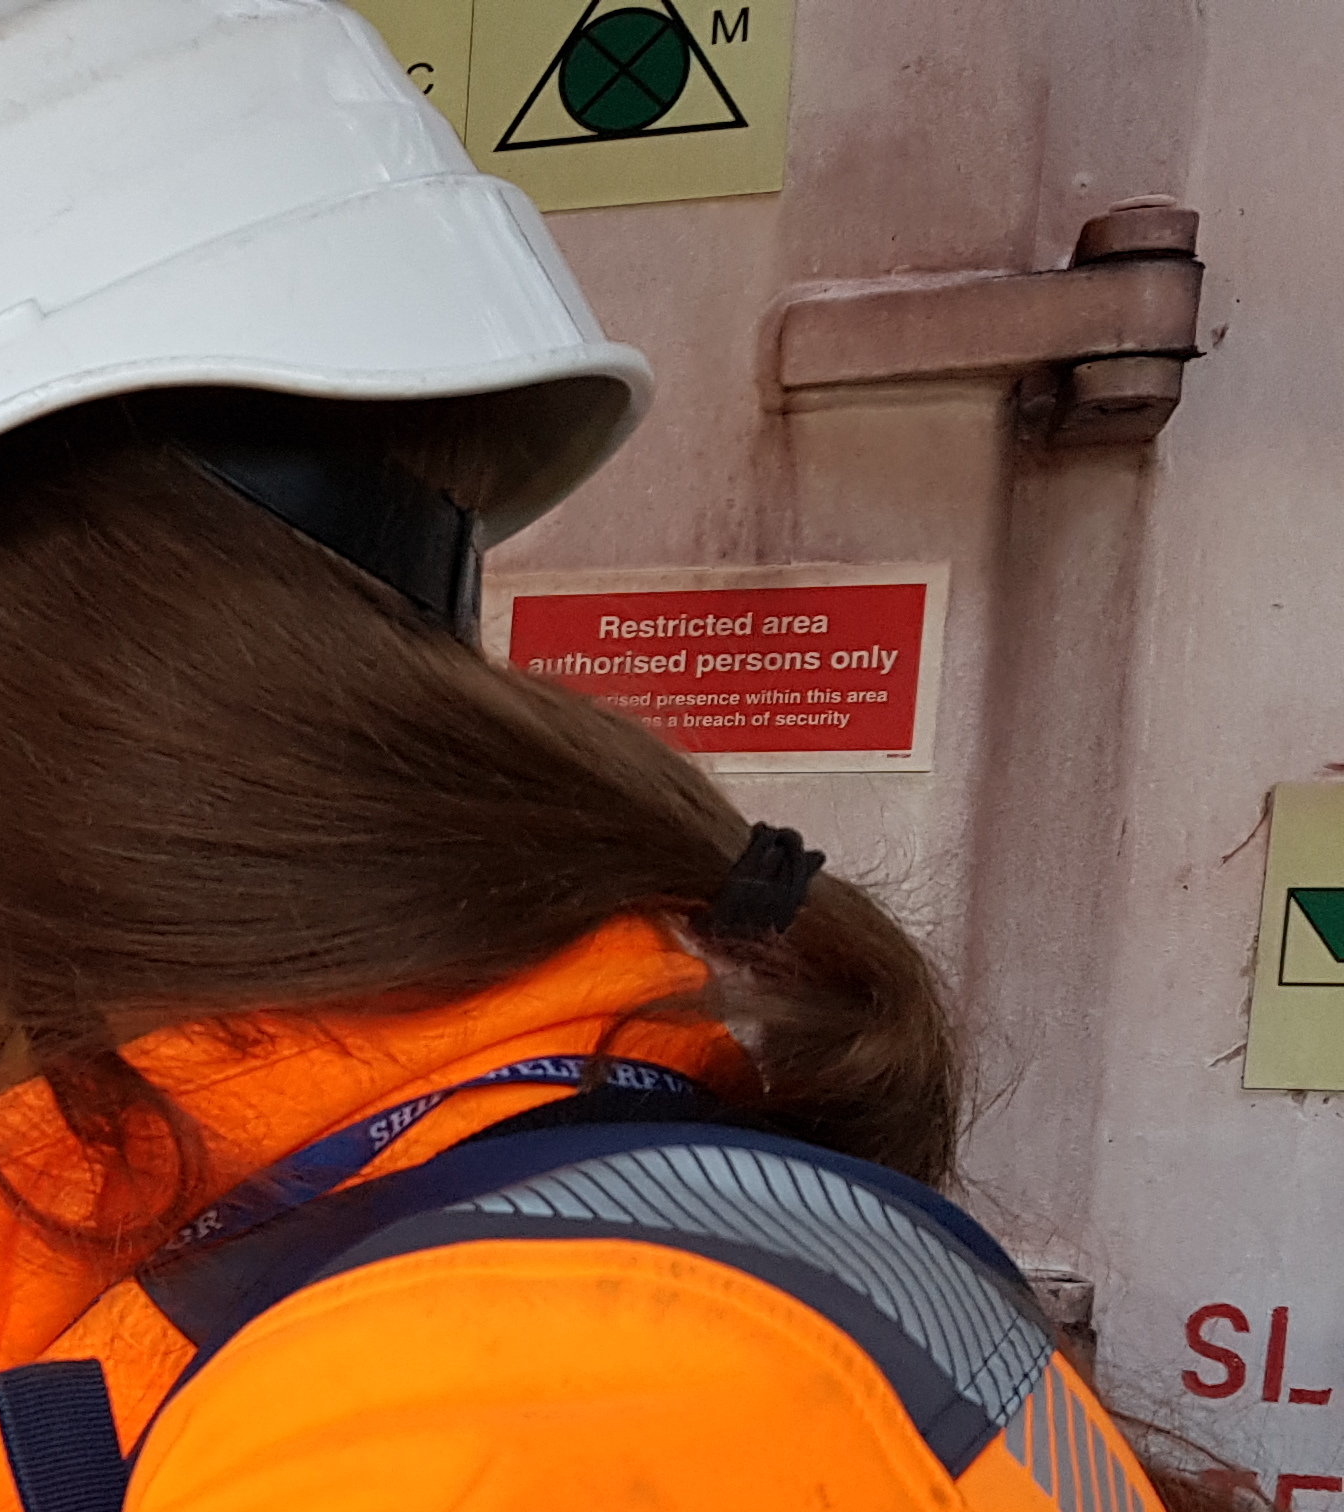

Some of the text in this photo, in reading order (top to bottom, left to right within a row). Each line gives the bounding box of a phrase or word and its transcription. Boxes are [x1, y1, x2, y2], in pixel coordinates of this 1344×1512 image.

[710, 6, 750, 46] M
[598, 612, 829, 640] Restricted area
[528, 644, 899, 679] authorised persons only
[656, 690, 740, 710] presence
[745, 688, 802, 705] within
[806, 687, 842, 704] this
[846, 689, 889, 704] area
[667, 716, 678, 728] a
[683, 711, 747, 728] breach
[750, 711, 772, 727] of
[774, 710, 850, 730] security
